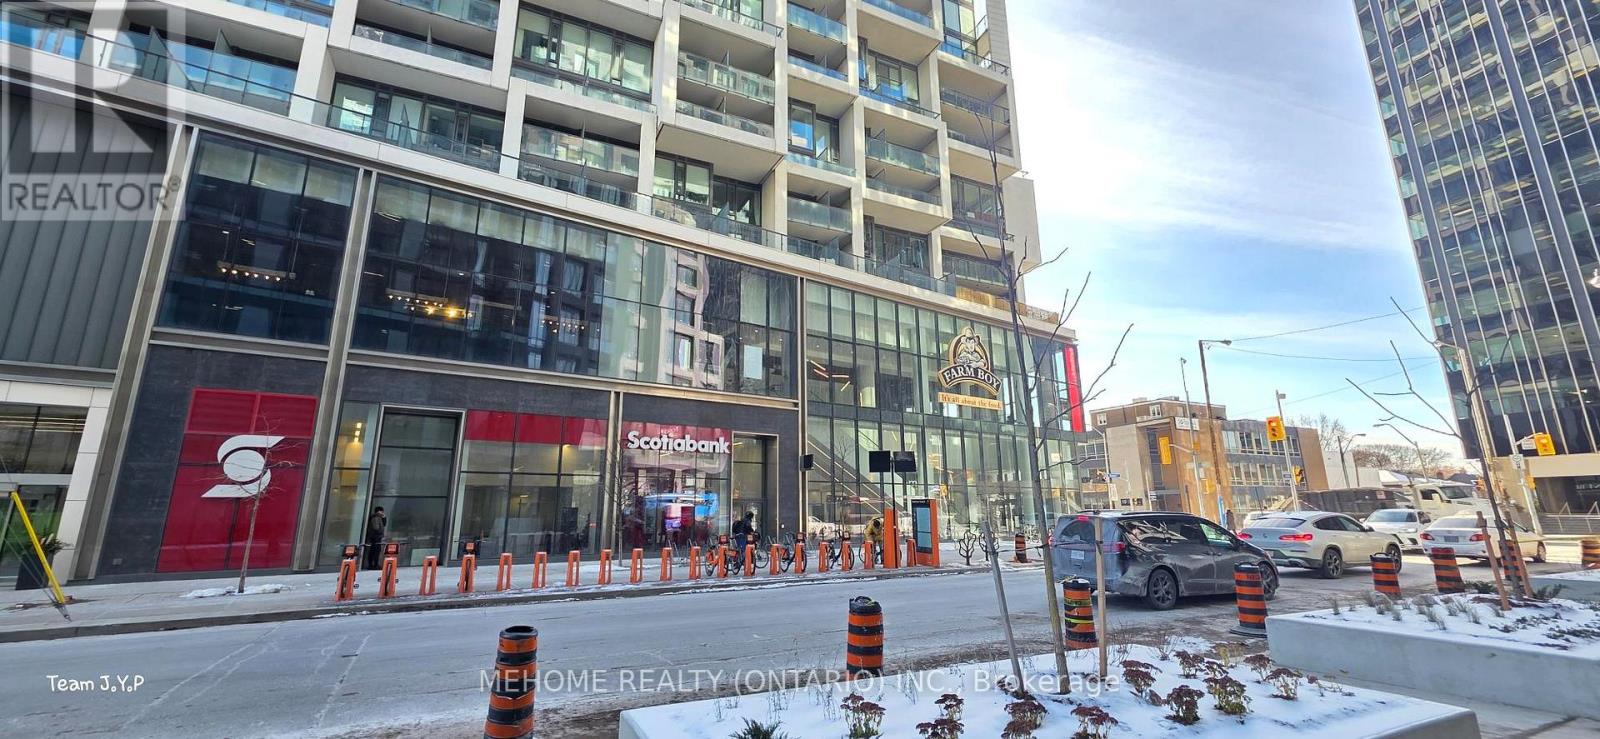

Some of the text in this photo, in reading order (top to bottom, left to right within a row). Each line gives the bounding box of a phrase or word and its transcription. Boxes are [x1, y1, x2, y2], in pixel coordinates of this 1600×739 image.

[943, 365, 1000, 388] FARM BOY
[961, 396, 977, 405] about
[978, 399, 987, 407] the
[627, 430, 730, 453] Scotiabank
